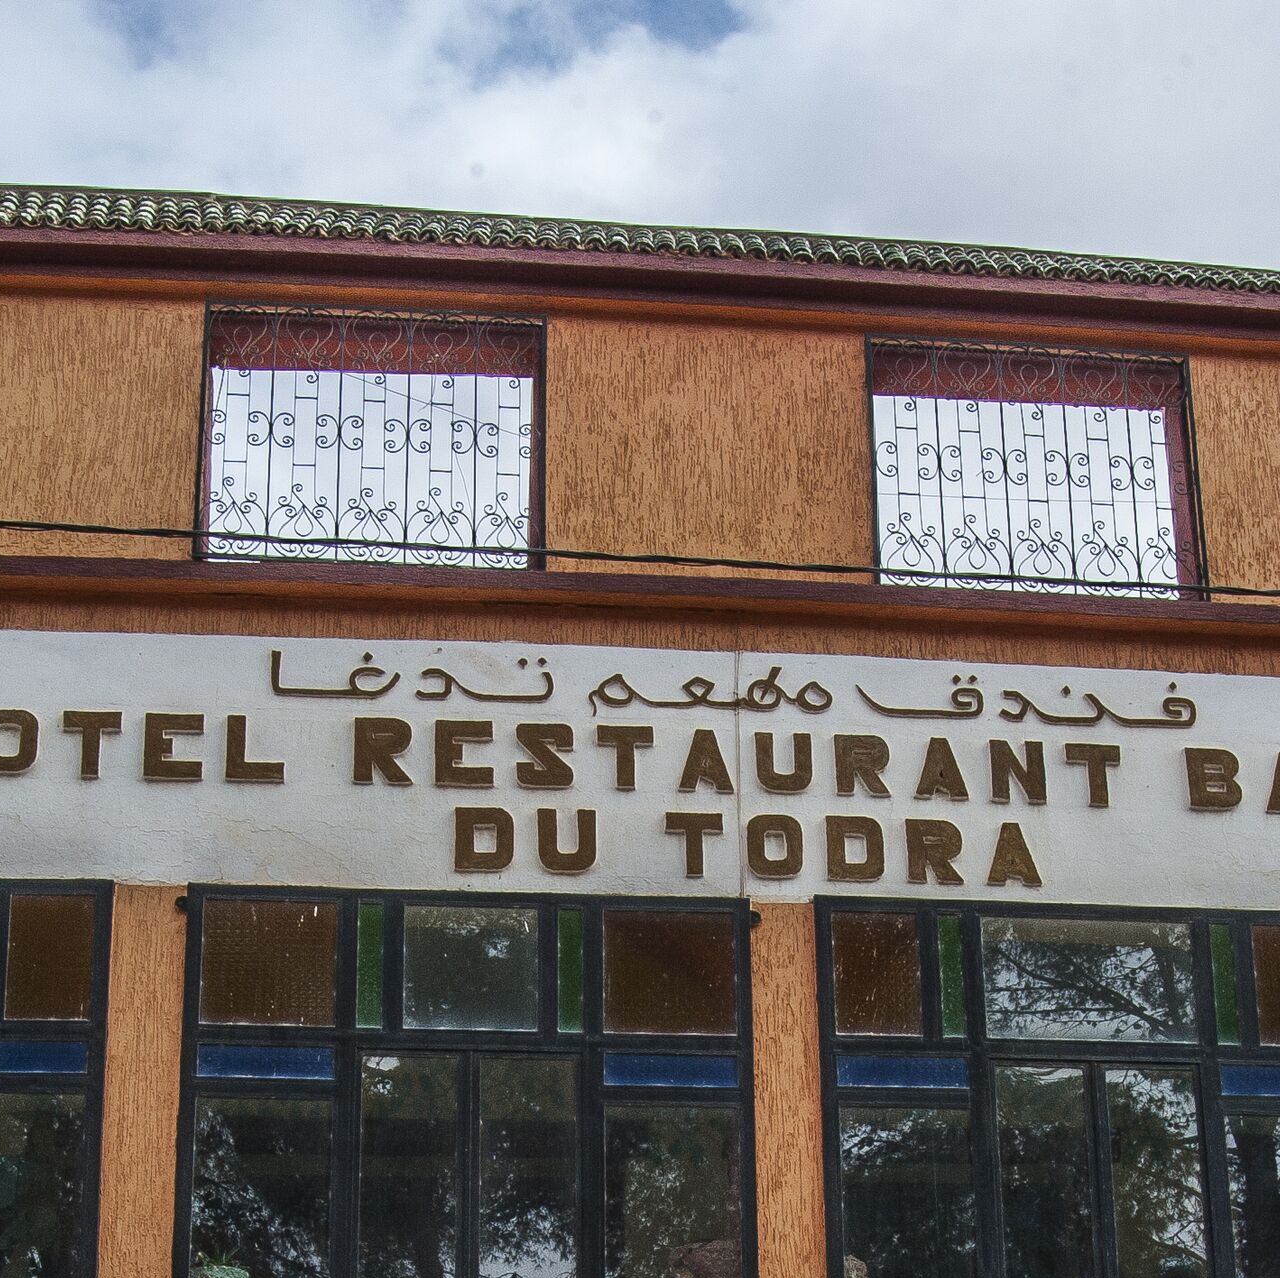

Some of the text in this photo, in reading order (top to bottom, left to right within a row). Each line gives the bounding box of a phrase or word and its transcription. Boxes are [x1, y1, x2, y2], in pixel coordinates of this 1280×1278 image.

[270, 650, 1197, 729] فندق مطعم تدغا
[351, 716, 1121, 808] RESTAURANT
[454, 806, 1044, 887] DU TODRA
